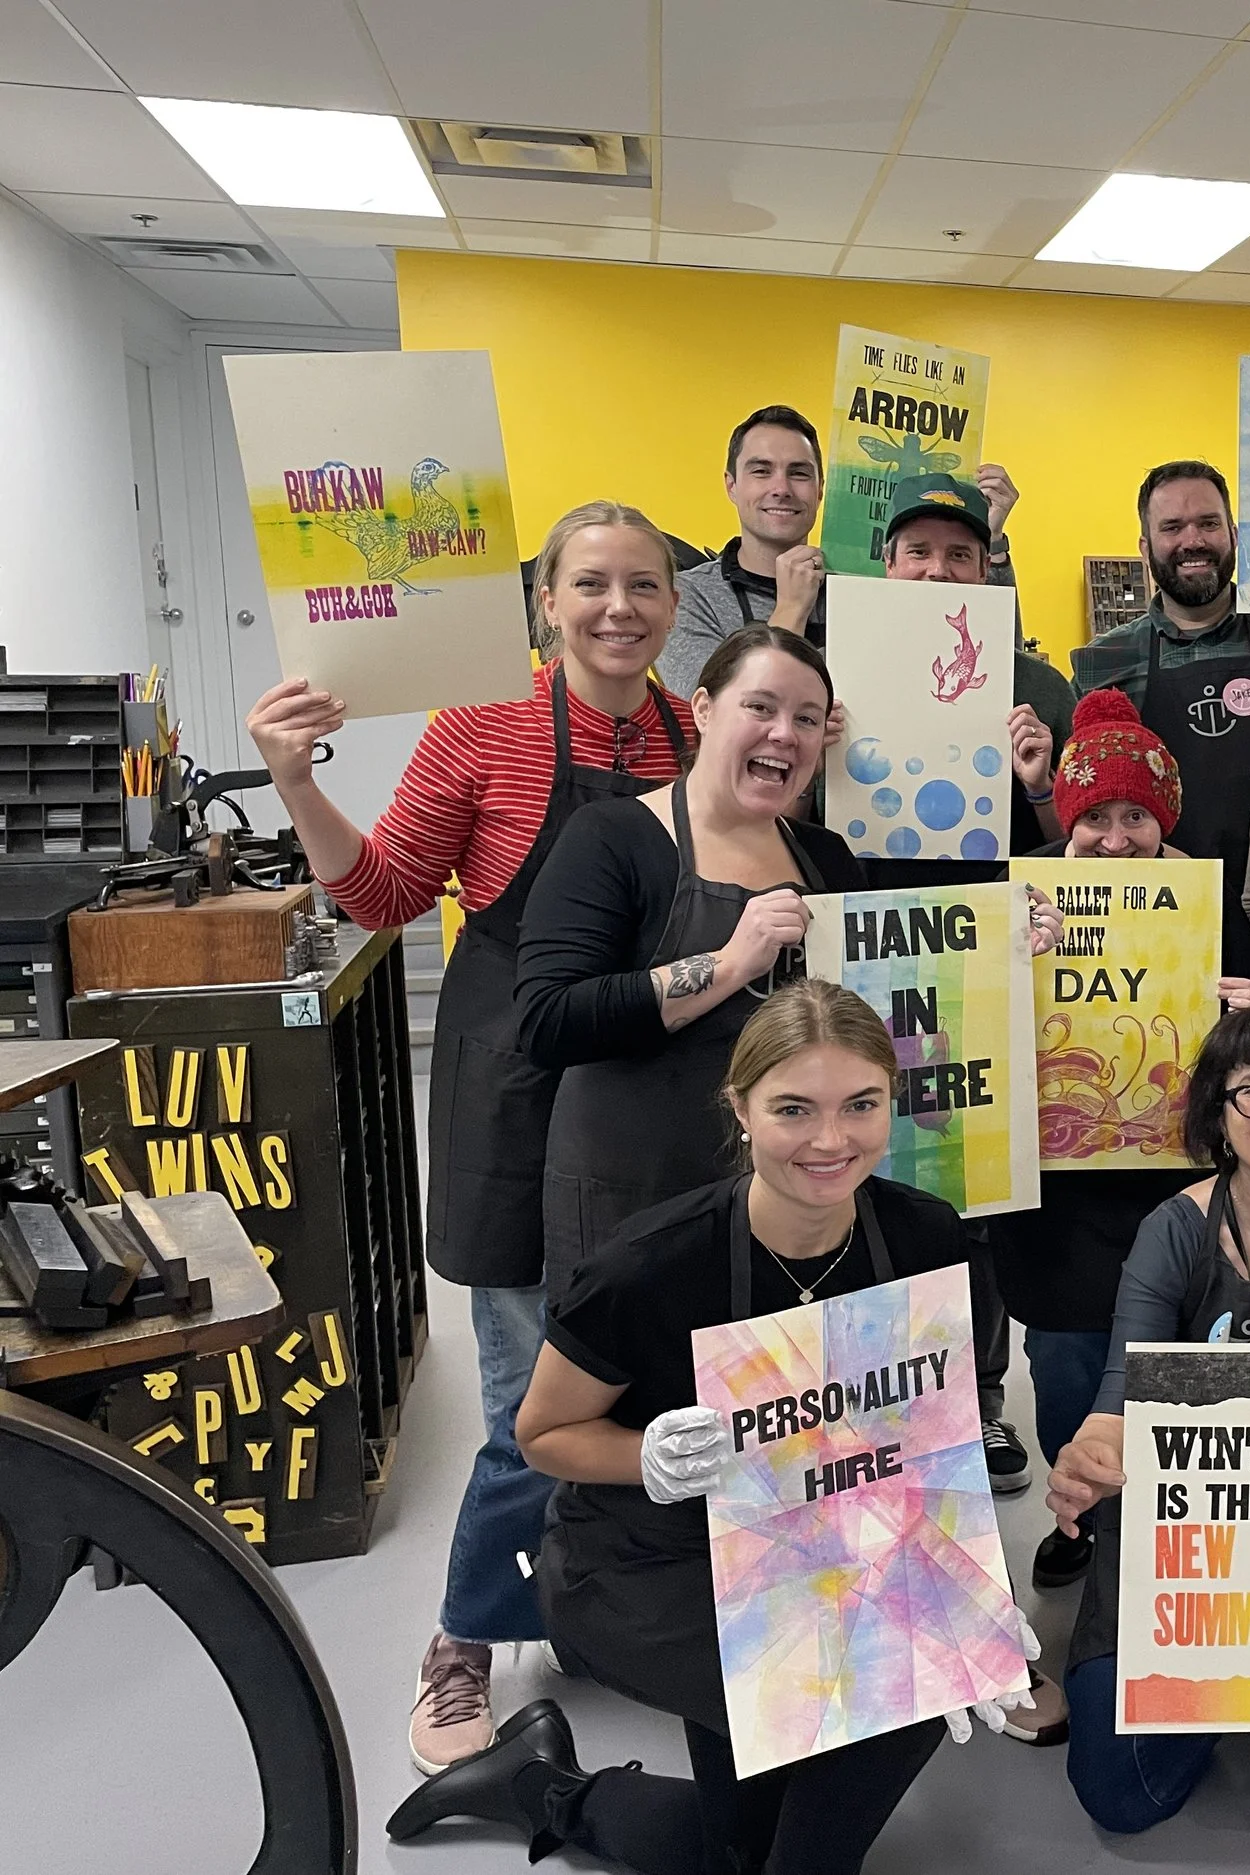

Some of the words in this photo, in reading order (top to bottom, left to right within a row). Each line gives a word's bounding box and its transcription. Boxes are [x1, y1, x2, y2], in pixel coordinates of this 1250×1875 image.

[864, 344, 885, 369] TIME
[893, 352, 918, 375] FLIES
[925, 359, 944, 381] LIKE
[952, 365, 965, 386] AN
[848, 386, 969, 442] ARROW
[868, 500, 888, 522] LIKE
[1056, 886, 1112, 916] BALLET
[1123, 886, 1147, 910] FOR
[1152, 886, 1179, 911] A
[844, 904, 977, 961] HANG
[890, 986, 938, 1038] IN
[1054, 968, 1148, 1003] DAY
[123, 1046, 247, 1128] LUV
[731, 1348, 949, 1454] PERSONALITY
[804, 1442, 903, 1502] HIRE
[1157, 1483, 1189, 1521] IS
[1155, 1524, 1236, 1579] NEW
